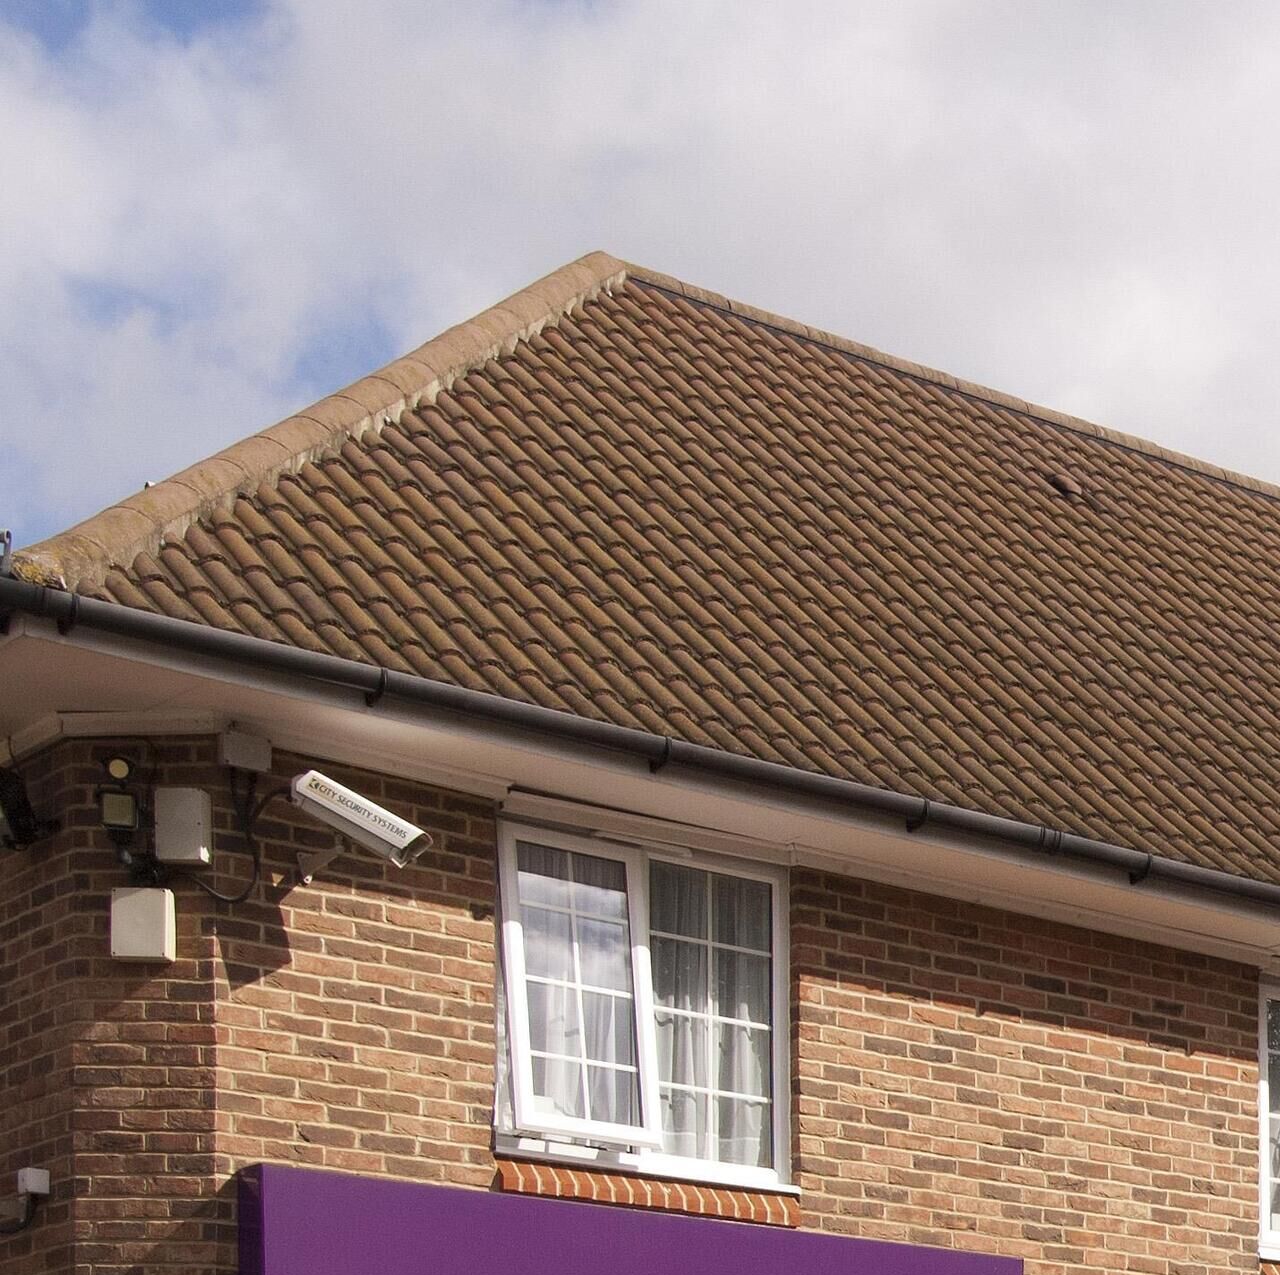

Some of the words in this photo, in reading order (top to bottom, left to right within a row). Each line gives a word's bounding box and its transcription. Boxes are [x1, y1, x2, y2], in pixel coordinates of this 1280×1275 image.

[319, 784, 337, 799] CITY
[338, 795, 374, 819] SECURITY
[373, 815, 408, 839] SYSTEMS
